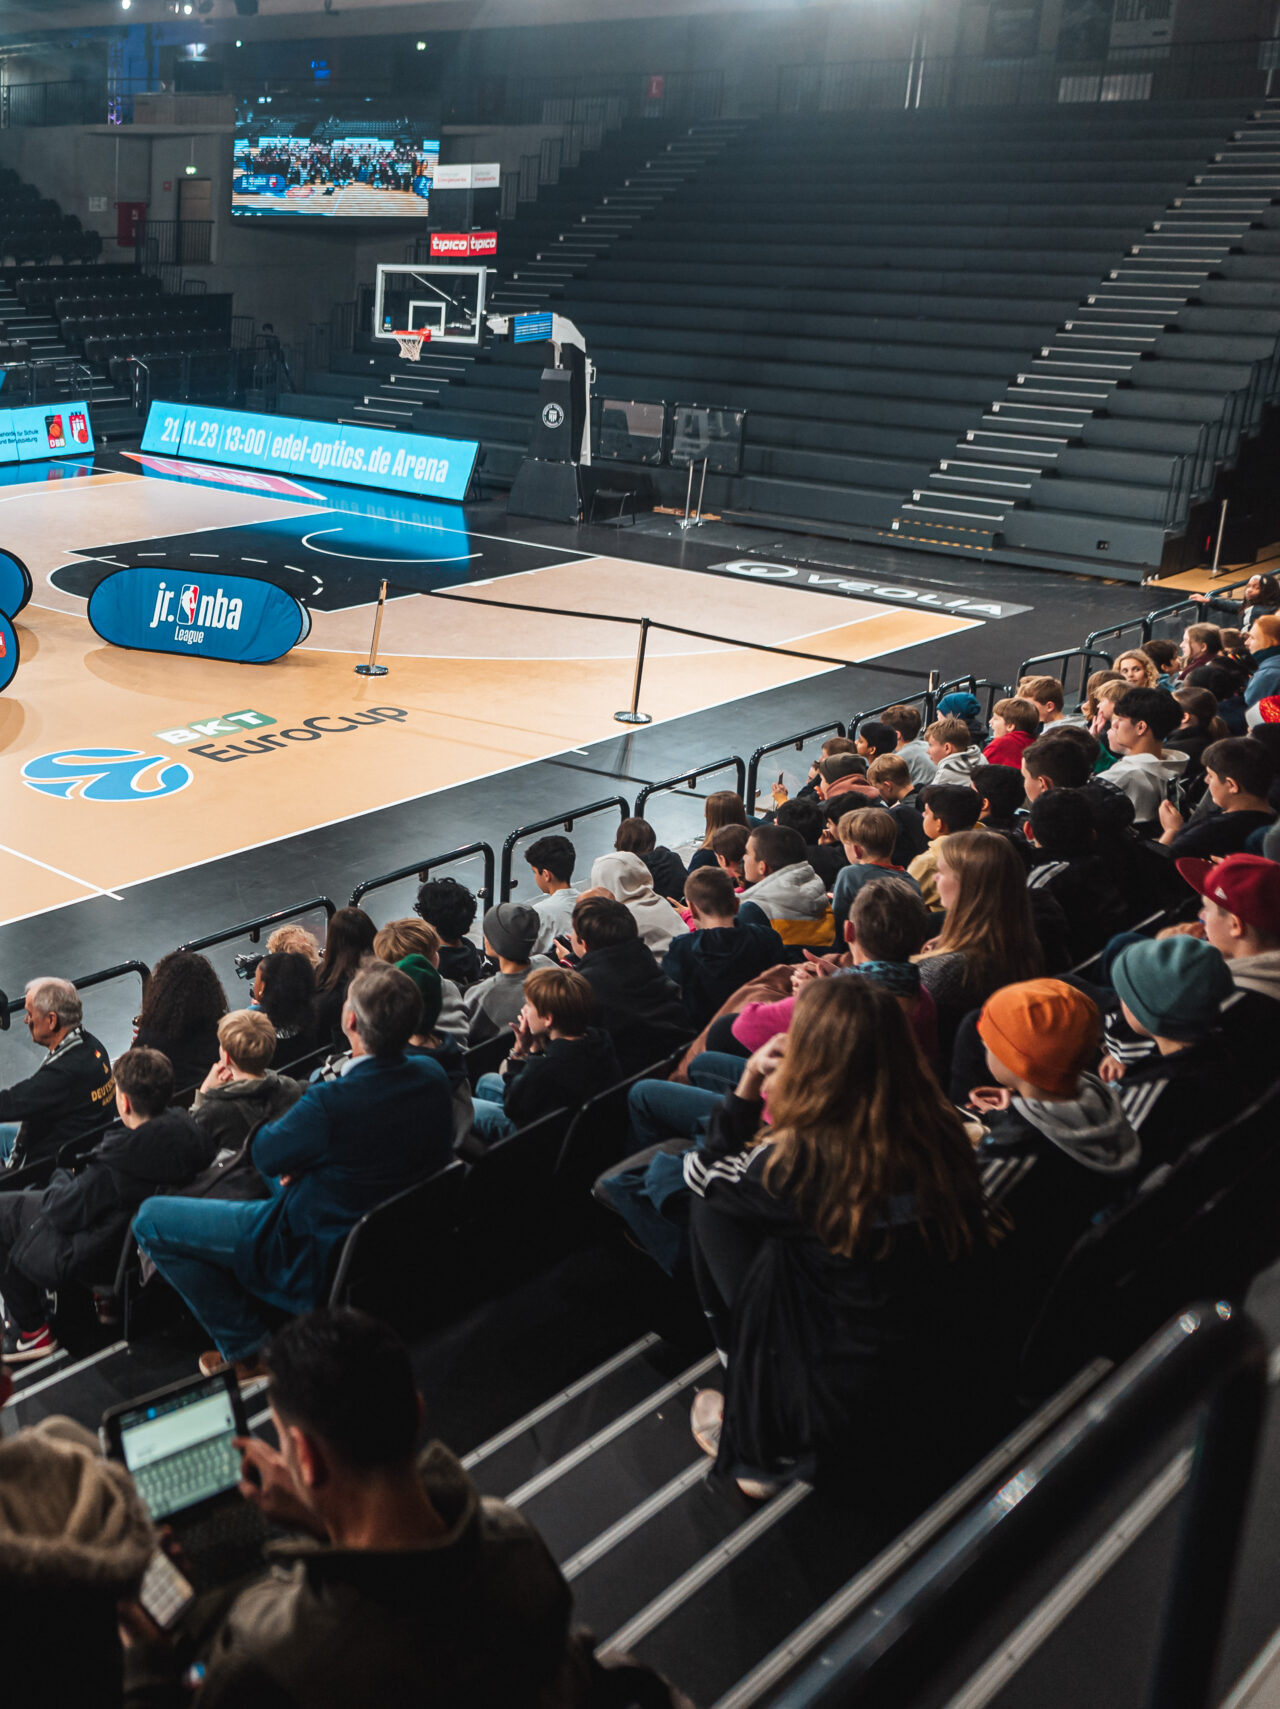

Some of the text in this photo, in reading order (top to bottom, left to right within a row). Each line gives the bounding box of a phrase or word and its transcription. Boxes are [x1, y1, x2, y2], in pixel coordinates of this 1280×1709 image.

[432, 236, 468, 252] tipico
[470, 235, 496, 252] tipico
[161, 416, 449, 483] 21.11.23 13:00 edel-optics.de Arena
[197, 588, 243, 631] nba
[806, 573, 1003, 617] VEOLIA
[174, 625, 205, 645] League
[154, 709, 264, 747] BKT
[188, 706, 409, 763] EuroCup
